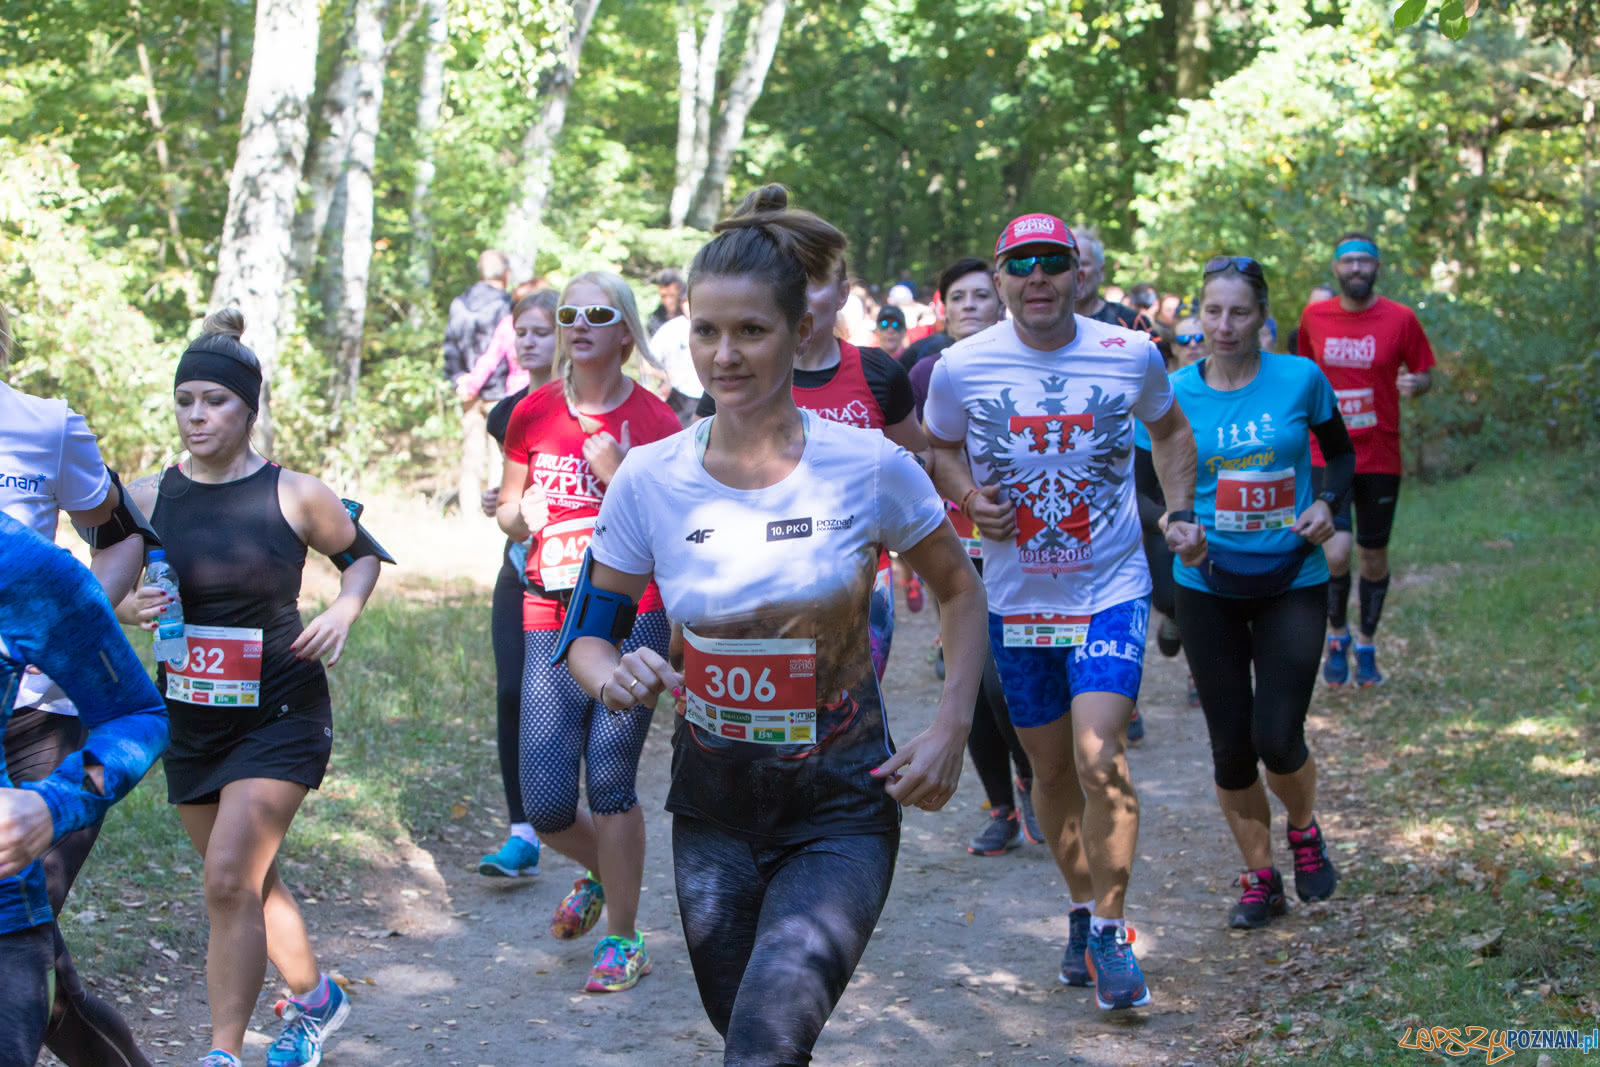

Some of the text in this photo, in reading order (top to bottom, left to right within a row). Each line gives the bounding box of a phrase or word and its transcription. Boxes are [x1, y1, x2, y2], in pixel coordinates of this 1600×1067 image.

[1238, 487, 1276, 508] 131
[786, 523, 809, 535] PKO
[1019, 546, 1092, 562] 1918-2018
[191, 646, 225, 674] 32
[704, 665, 776, 703] 306
